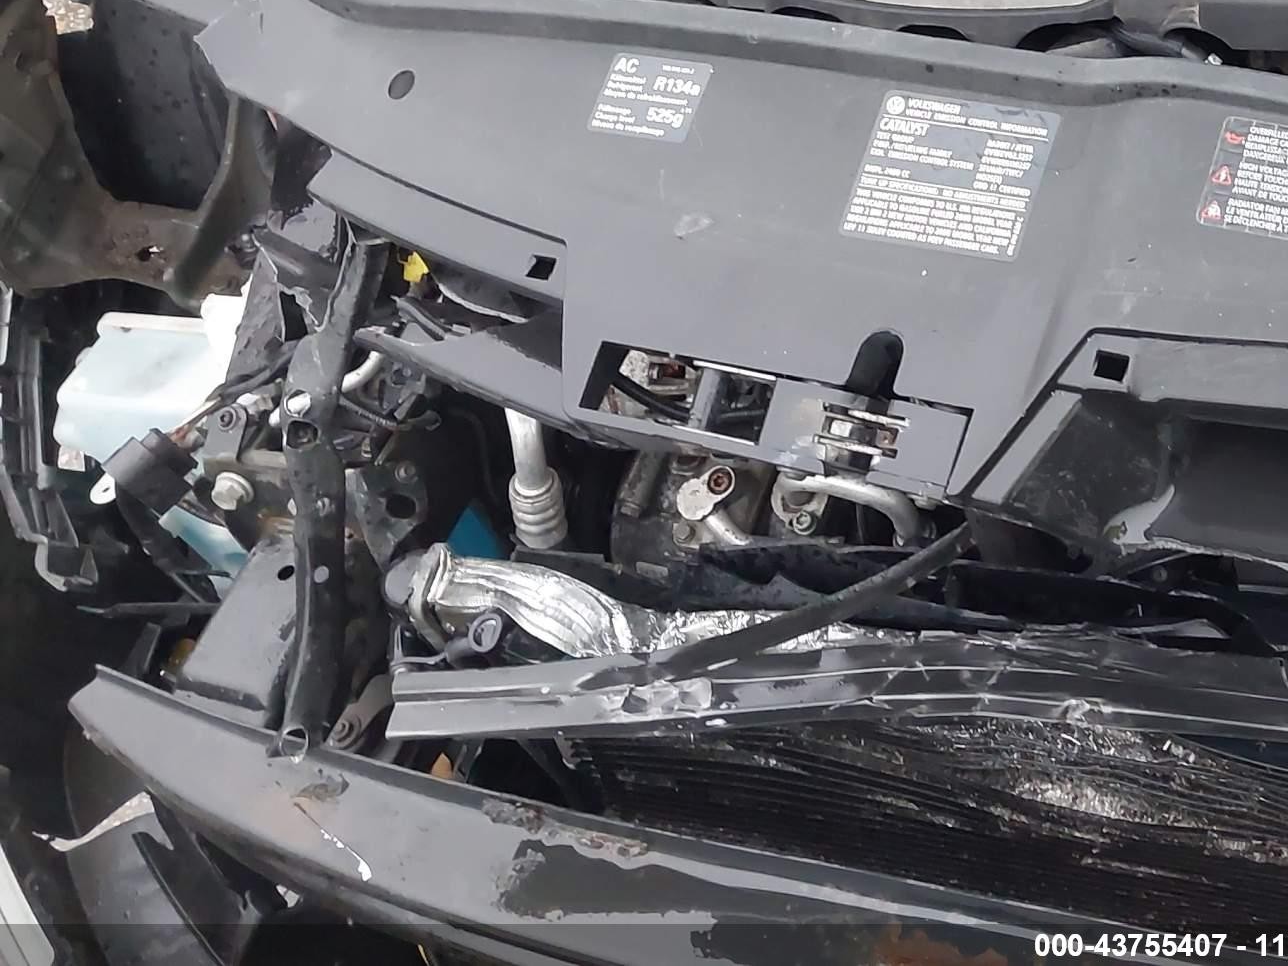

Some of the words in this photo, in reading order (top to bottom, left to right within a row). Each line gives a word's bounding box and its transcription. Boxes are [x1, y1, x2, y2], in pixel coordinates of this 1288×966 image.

[614, 57, 640, 74] AC
[653, 76, 701, 96] R134a
[908, 97, 962, 115] VOLKSWAGEN
[646, 106, 684, 128] 525g
[880, 117, 930, 137] CATALYST
[1247, 133, 1280, 146] DAMAGE
[1237, 169, 1263, 181] BEFORE
[1239, 162, 1259, 173] HIGH
[1234, 177, 1259, 190] HAUTE
[1232, 185, 1258, 197] AVANT
[1257, 190, 1269, 200] DE
[1226, 204, 1236, 215] LE
[1228, 197, 1265, 211] RADIATOR
[1265, 202, 1281, 213] FAN
[1224, 214, 1234, 224] SE
